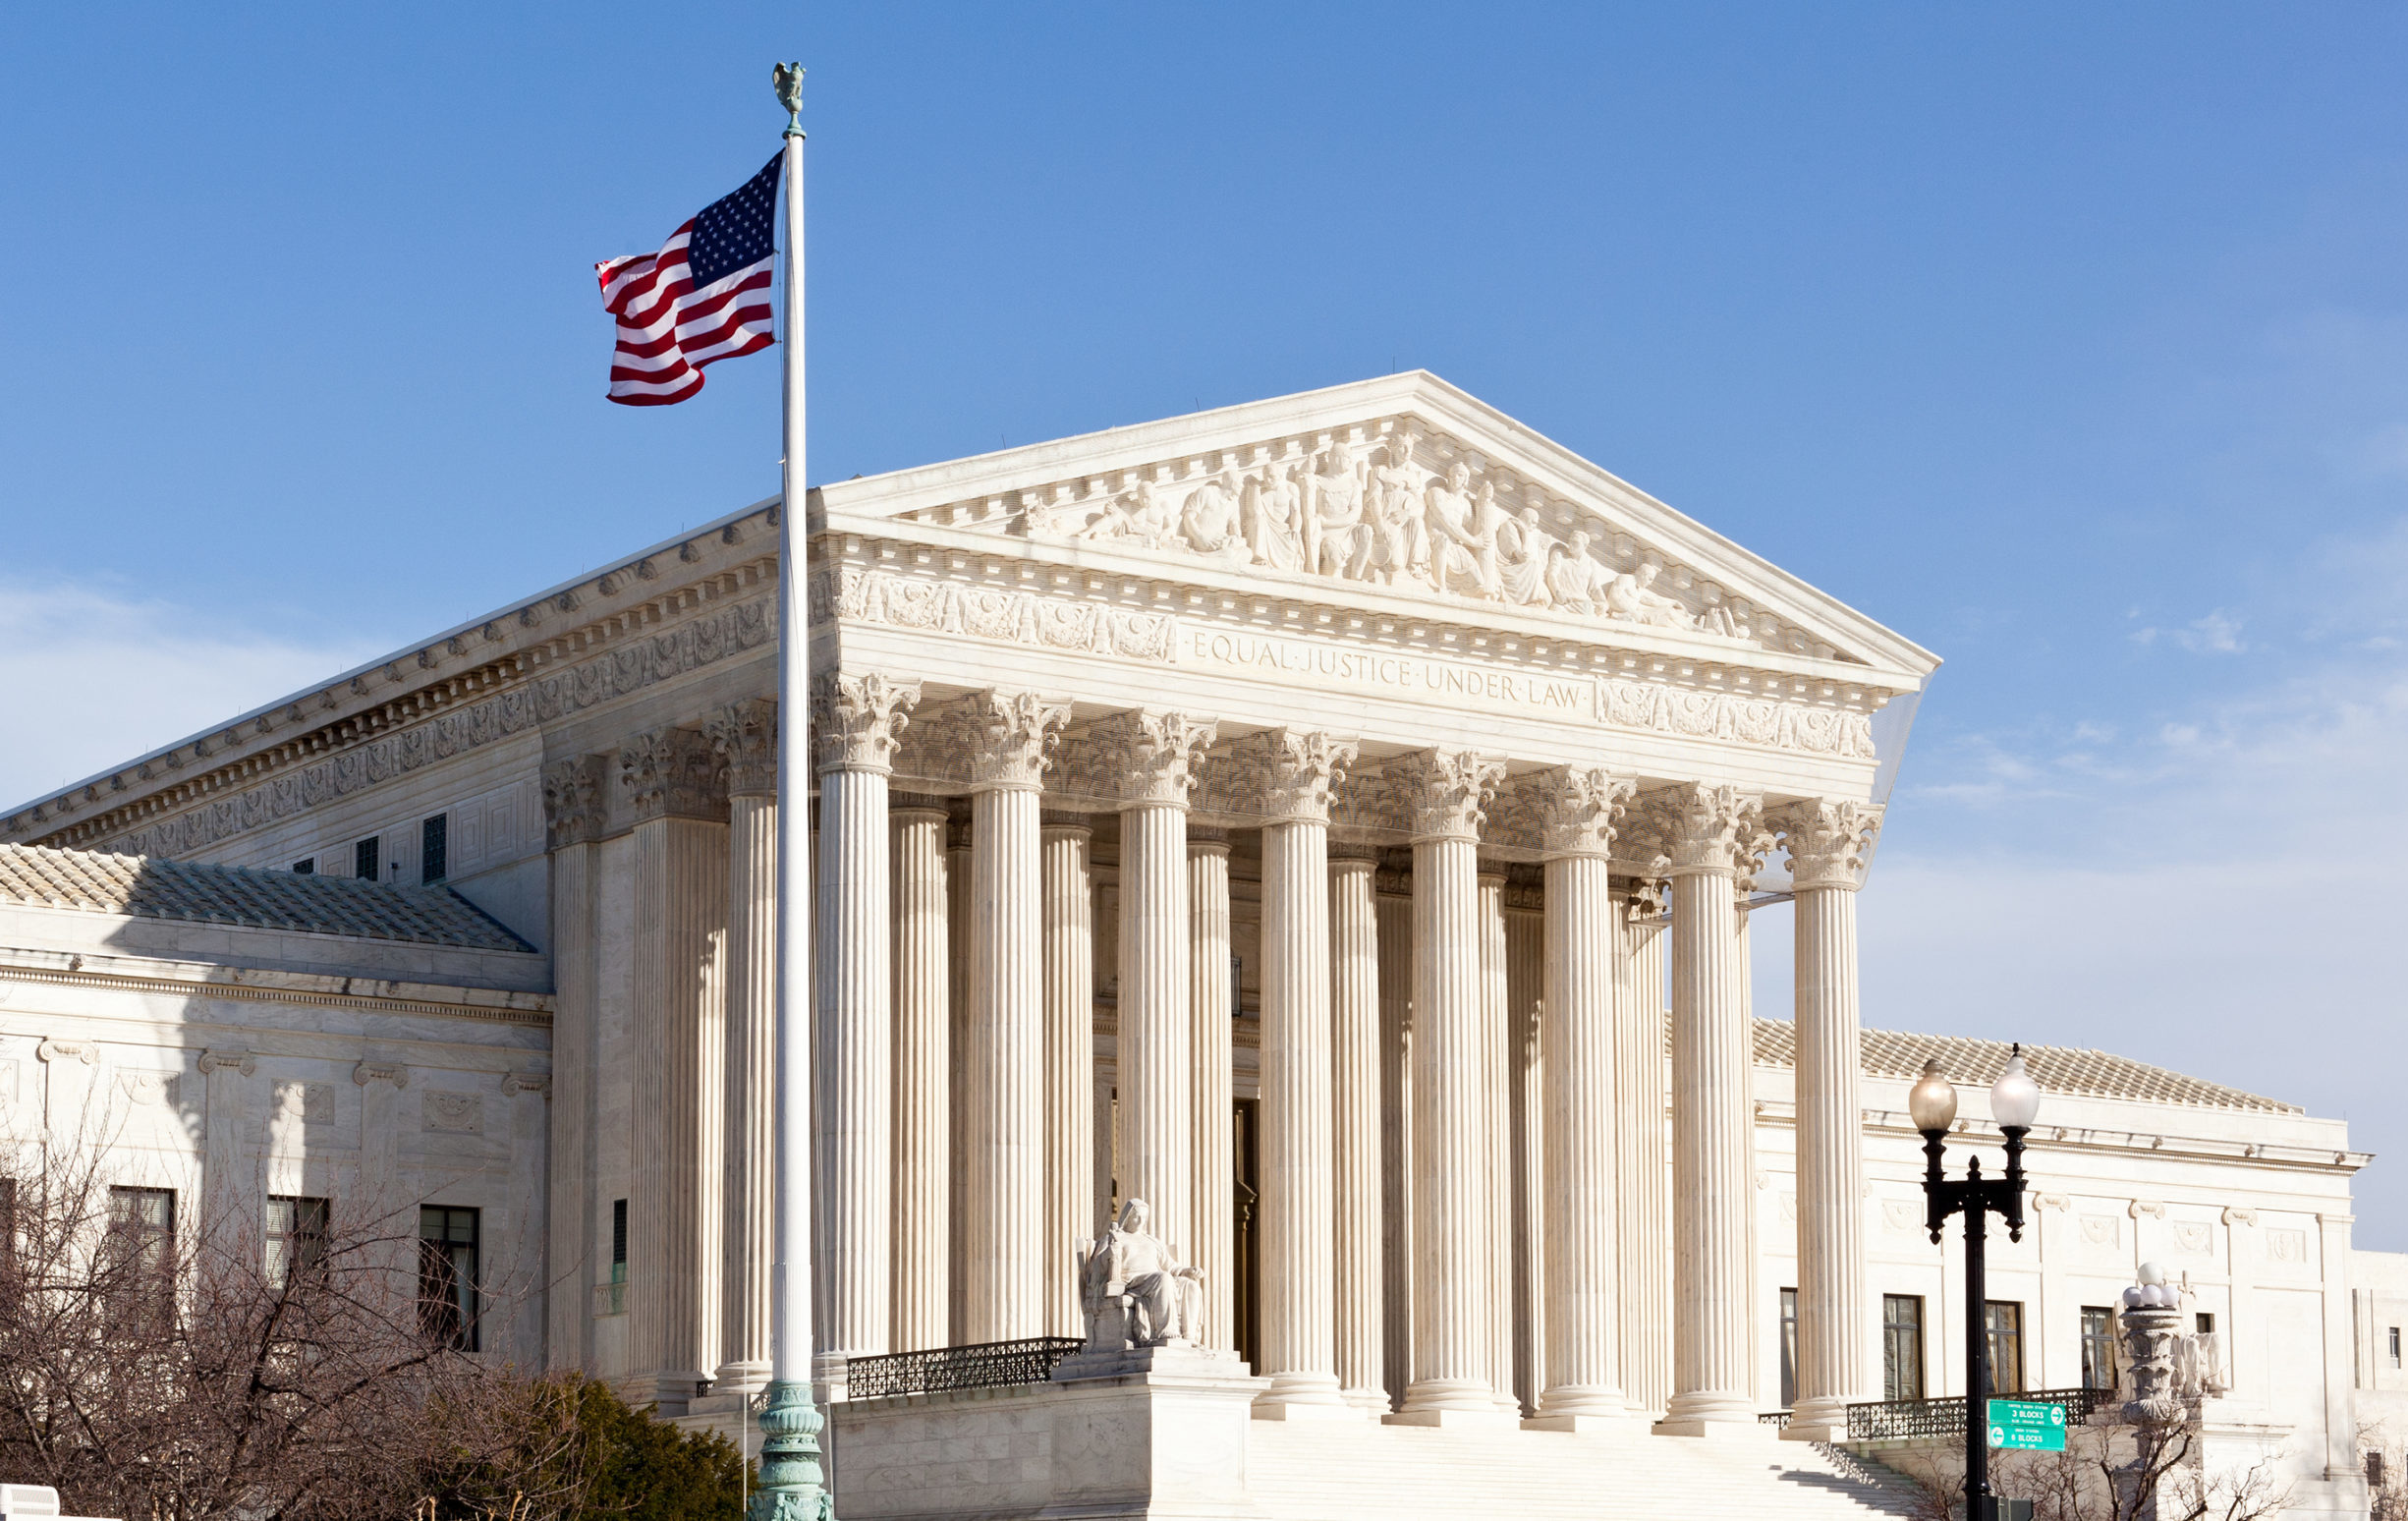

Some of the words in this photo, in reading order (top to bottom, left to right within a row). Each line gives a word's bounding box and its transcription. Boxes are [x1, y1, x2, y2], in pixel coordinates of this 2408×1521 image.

[1194, 632, 1292, 670] EQUAL
[1300, 648, 1411, 686] JUSTICE
[1426, 664, 1519, 702] UNDER
[1529, 679, 1580, 708] LAW
[2019, 1410, 2044, 1419] BLOCKS
[2018, 1434, 2043, 1442] BLOCKS
